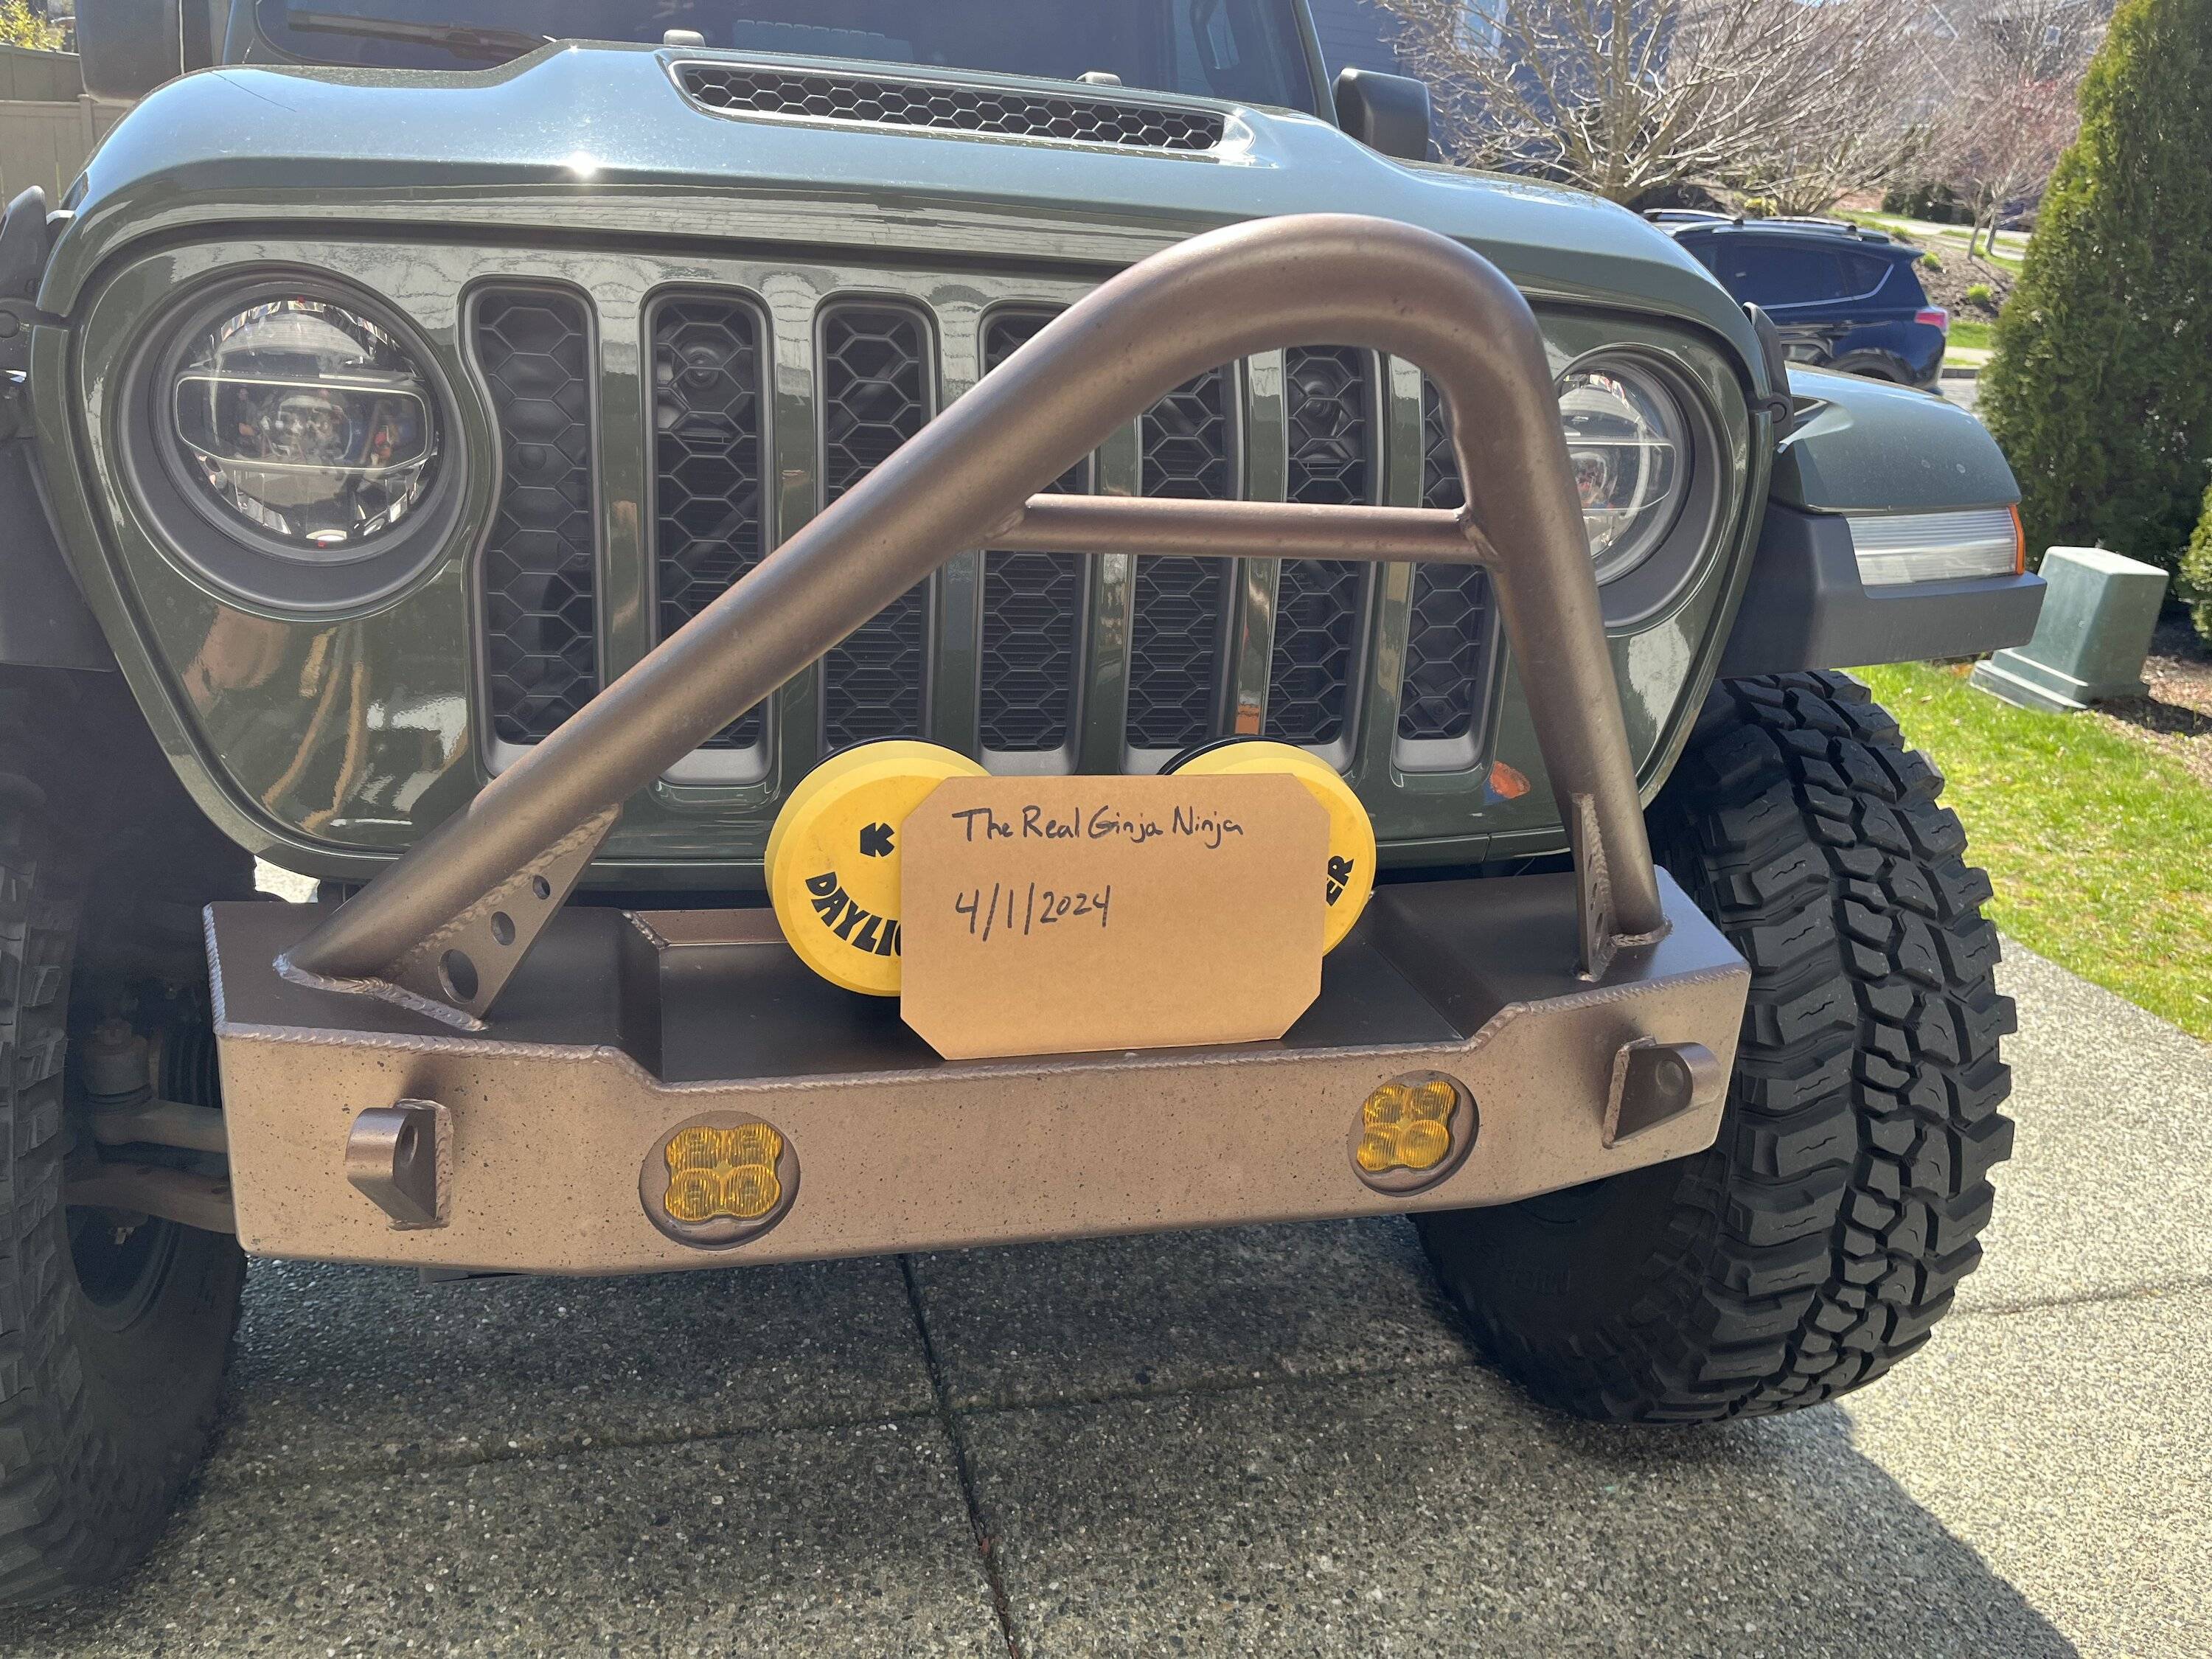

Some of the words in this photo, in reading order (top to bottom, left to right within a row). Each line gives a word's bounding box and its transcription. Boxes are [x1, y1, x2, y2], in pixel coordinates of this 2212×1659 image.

[952, 807, 1013, 841] The
[1023, 805, 1080, 838] Real
[1088, 805, 1164, 843] Ginja
[1172, 806, 1243, 849] Ninja
[956, 883, 1110, 942] 4/1/2024
